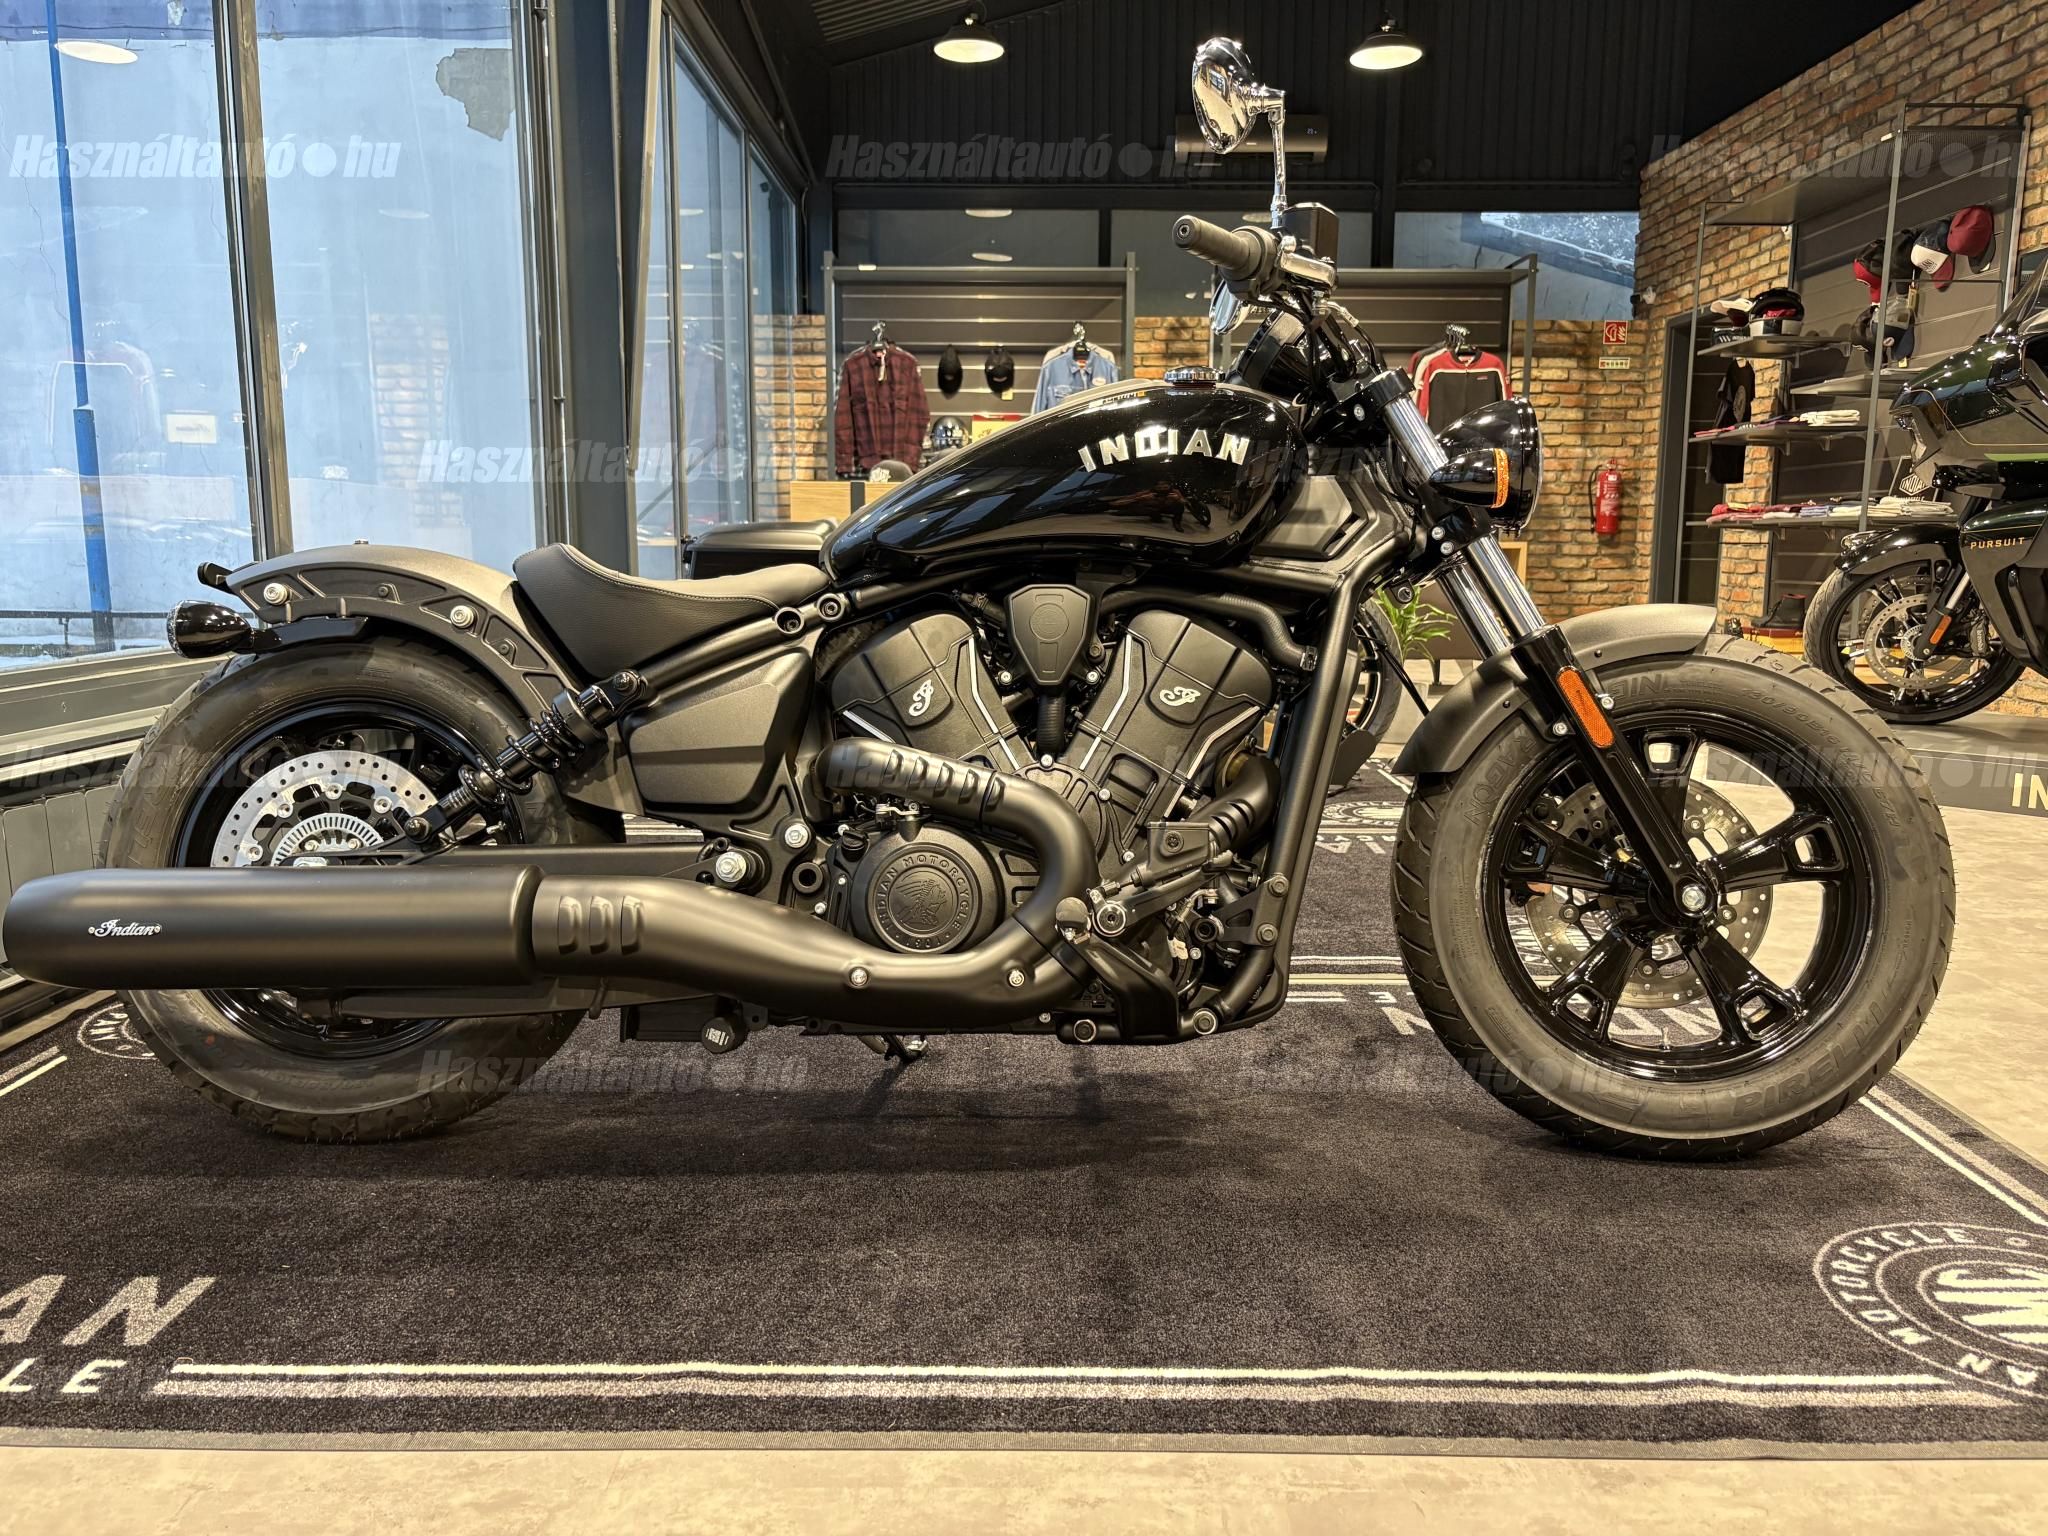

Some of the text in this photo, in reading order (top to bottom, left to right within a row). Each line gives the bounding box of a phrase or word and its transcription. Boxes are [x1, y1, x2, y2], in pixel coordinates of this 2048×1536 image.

[1078, 426, 1249, 472] INDIAN
[1970, 537, 2025, 550] PURSUIT
[877, 854, 970, 931] INDIAN MOTORCYCLE
[94, 918, 155, 937] Indian
